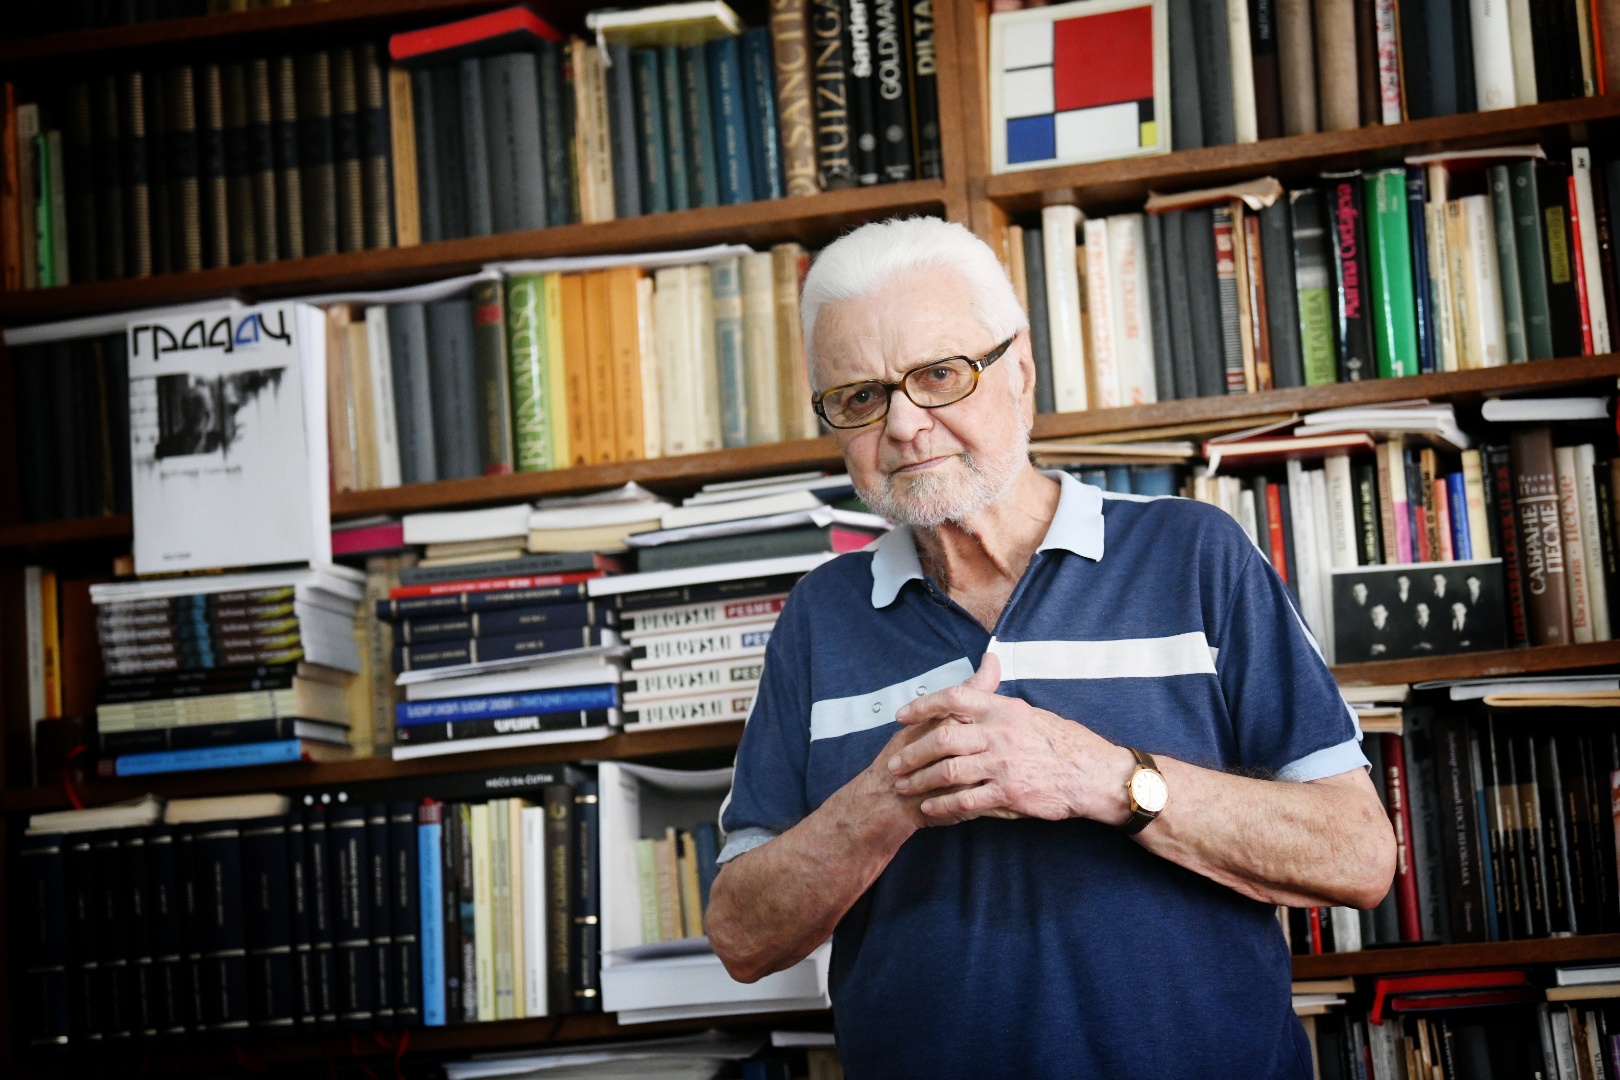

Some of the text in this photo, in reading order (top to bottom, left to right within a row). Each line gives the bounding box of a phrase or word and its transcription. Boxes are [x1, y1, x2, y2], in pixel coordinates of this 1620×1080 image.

[1336, 183, 1361, 318] Marina Cvetajeva
[1522, 503, 1547, 595] САБРАНЕ
[1540, 502, 1564, 573] ПЕСМЕ
[727, 603, 773, 617] PESME
